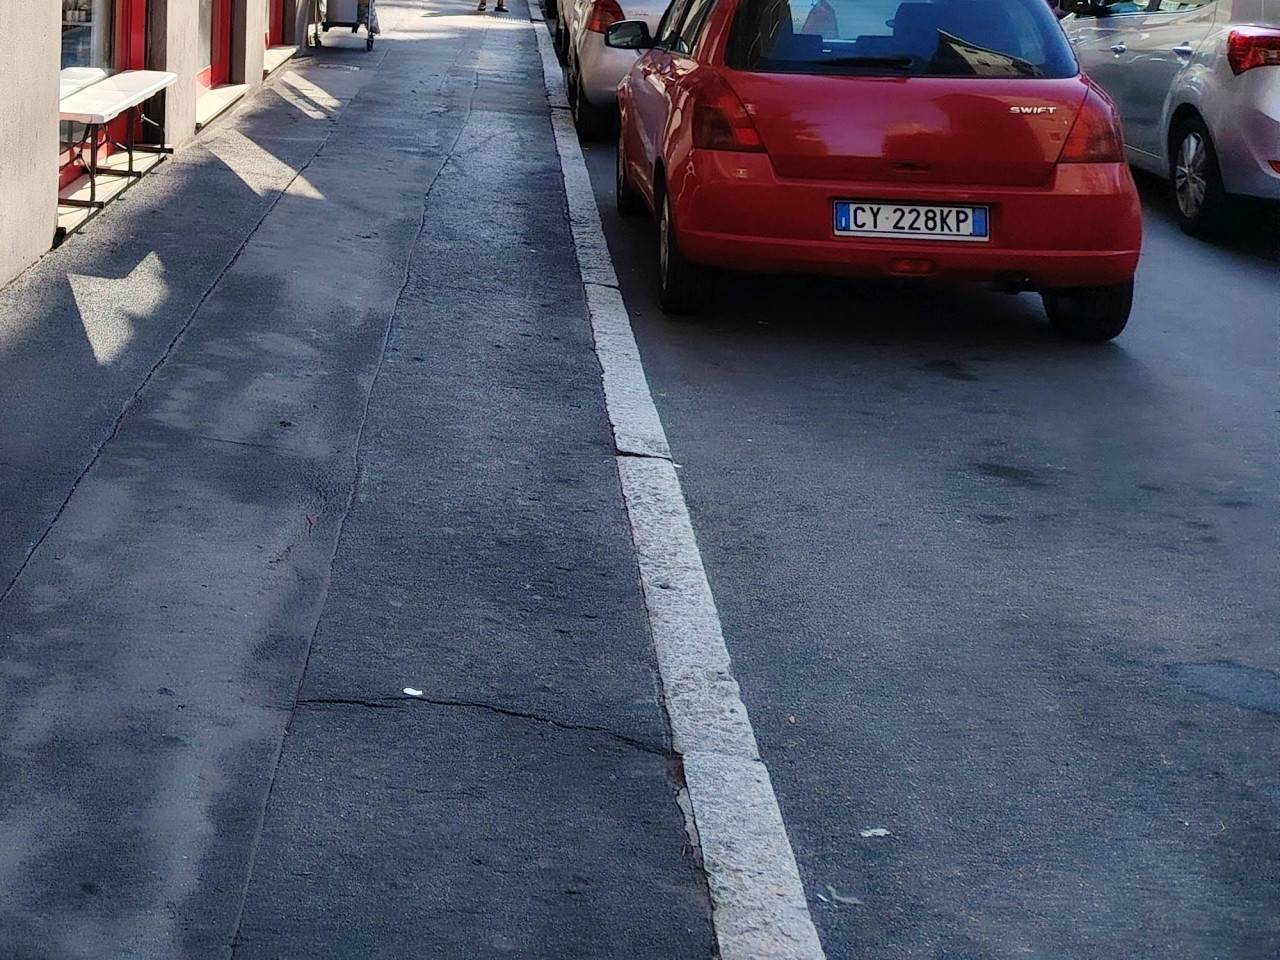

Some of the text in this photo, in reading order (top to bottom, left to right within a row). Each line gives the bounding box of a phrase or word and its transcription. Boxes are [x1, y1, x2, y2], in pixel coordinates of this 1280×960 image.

[1008, 106, 1057, 115] SWIFT
[853, 206, 882, 229] CY
[892, 207, 970, 233] 228KP
